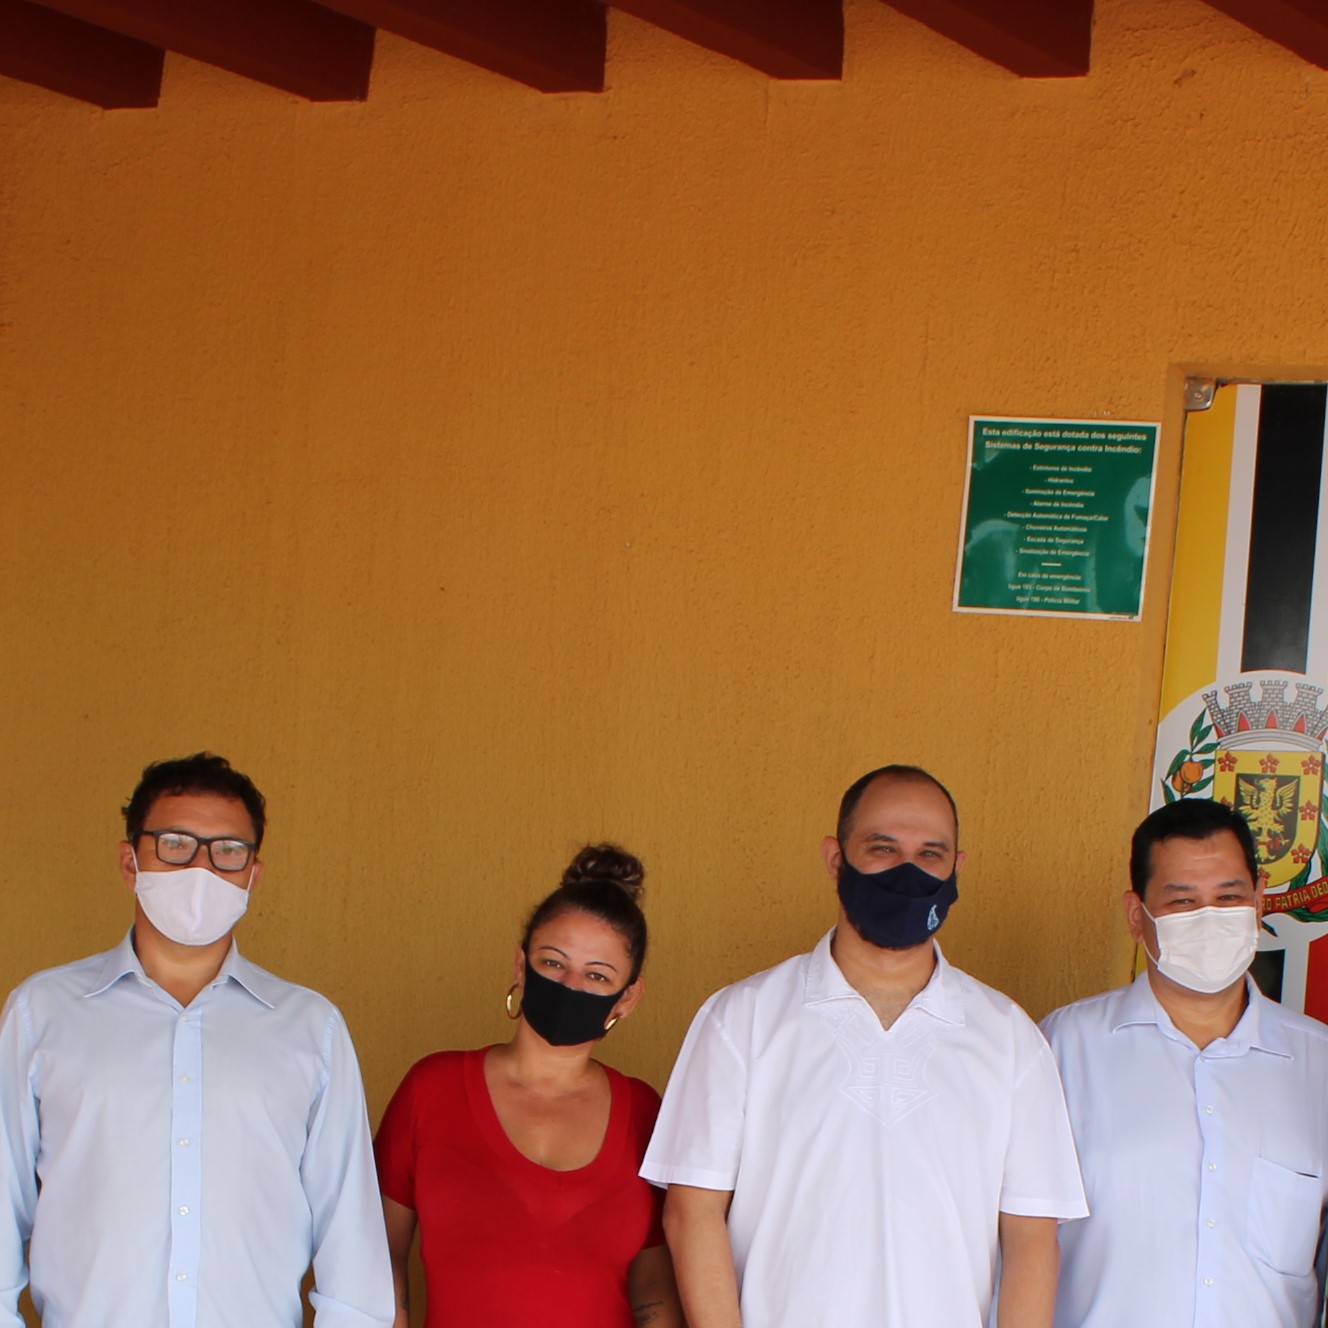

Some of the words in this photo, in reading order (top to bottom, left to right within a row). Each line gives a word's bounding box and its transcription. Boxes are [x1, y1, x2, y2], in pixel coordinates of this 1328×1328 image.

[983, 428, 1000, 436] Esta
[1002, 428, 1041, 438] edificação
[1108, 433, 1147, 441] seguintes
[985, 441, 1020, 450] Sistemas
[1034, 442, 1075, 452] Segurança
[1105, 444, 1141, 454] Incêndio:
[1276, 889, 1310, 908] PATRIA
